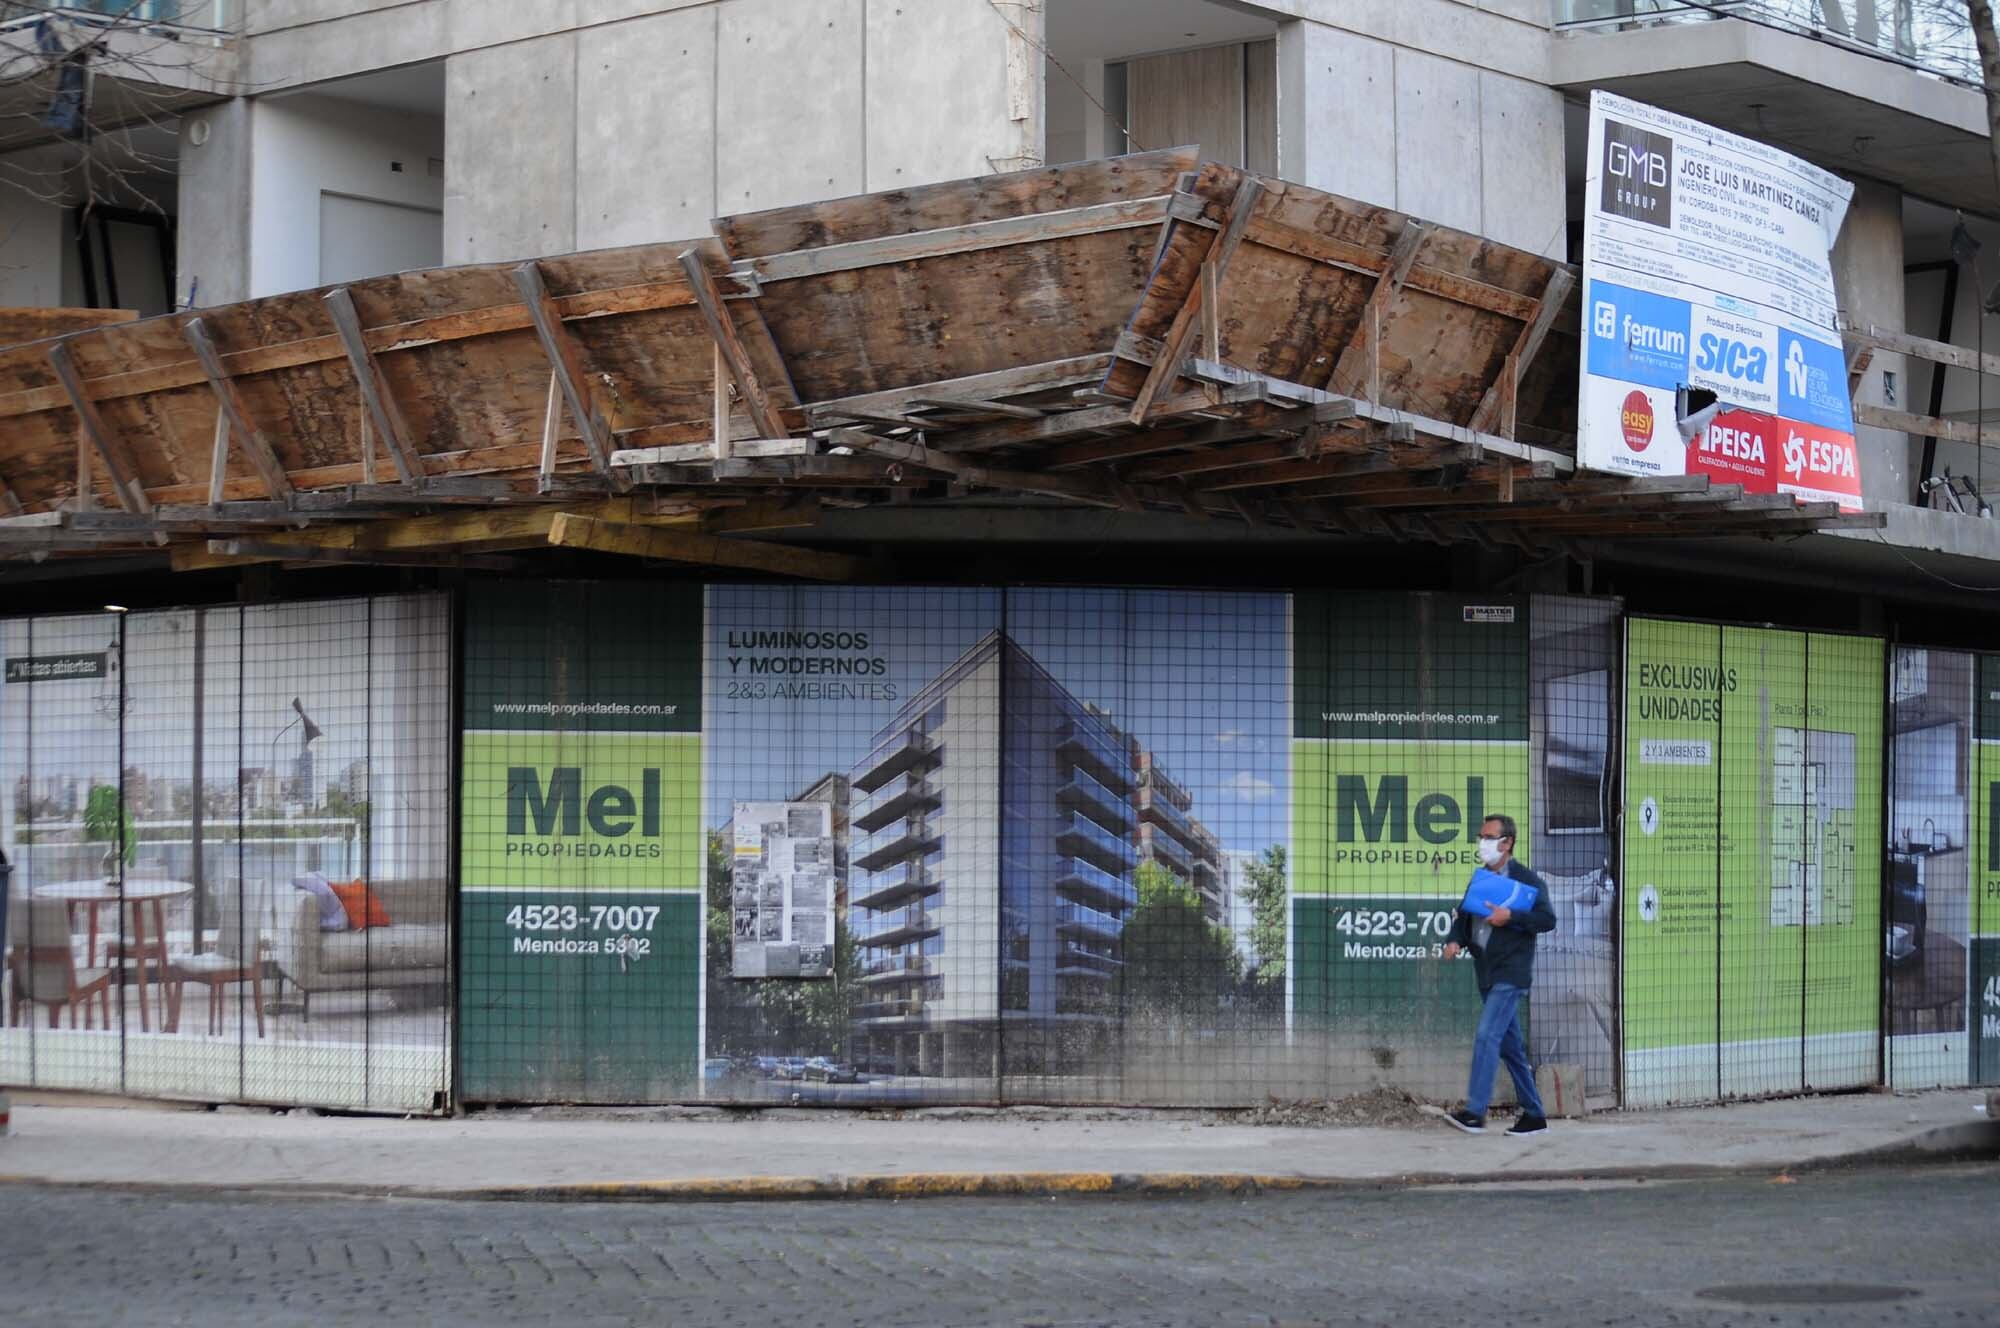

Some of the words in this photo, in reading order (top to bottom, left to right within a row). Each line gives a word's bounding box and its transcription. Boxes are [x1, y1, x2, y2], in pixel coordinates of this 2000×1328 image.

[1608, 142, 1666, 187] GMB
[1678, 176, 1718, 198] INGENIERO
[1681, 159, 1710, 181] JOSE
[1714, 168, 1739, 190] LUIS
[1742, 178, 1793, 210] MARTINEZ
[1617, 191, 1656, 211] GROUP
[1623, 313, 1686, 355] ferrum
[1706, 315, 1734, 331] Productos
[1623, 410, 1653, 435] easy
[1710, 425, 1766, 464] PEISA
[1631, 458, 1661, 471] empresas
[1810, 440, 1856, 478] ESPA
[728, 631, 869, 650] LUMINOSOS
[728, 656, 746, 675] Y
[749, 656, 886, 675] MODERNOS
[1639, 664, 1737, 693] EXCLUSIVAS
[728, 681, 767, 700] 2&3
[773, 681, 897, 701] AMBIENTES
[493, 702, 677, 718] www.melpropiedades.com.ar
[1322, 711, 1499, 724] www.melpropiedades.com.ar
[1639, 696, 1722, 722] UNIDADES
[506, 767, 661, 838] Mel
[1336, 774, 1485, 844] Mel
[506, 842, 661, 858] PROPIEDADES
[505, 905, 661, 931] 4523-7007
[513, 936, 599, 954] Mendoza
[1344, 942, 1426, 959] Mendoza
